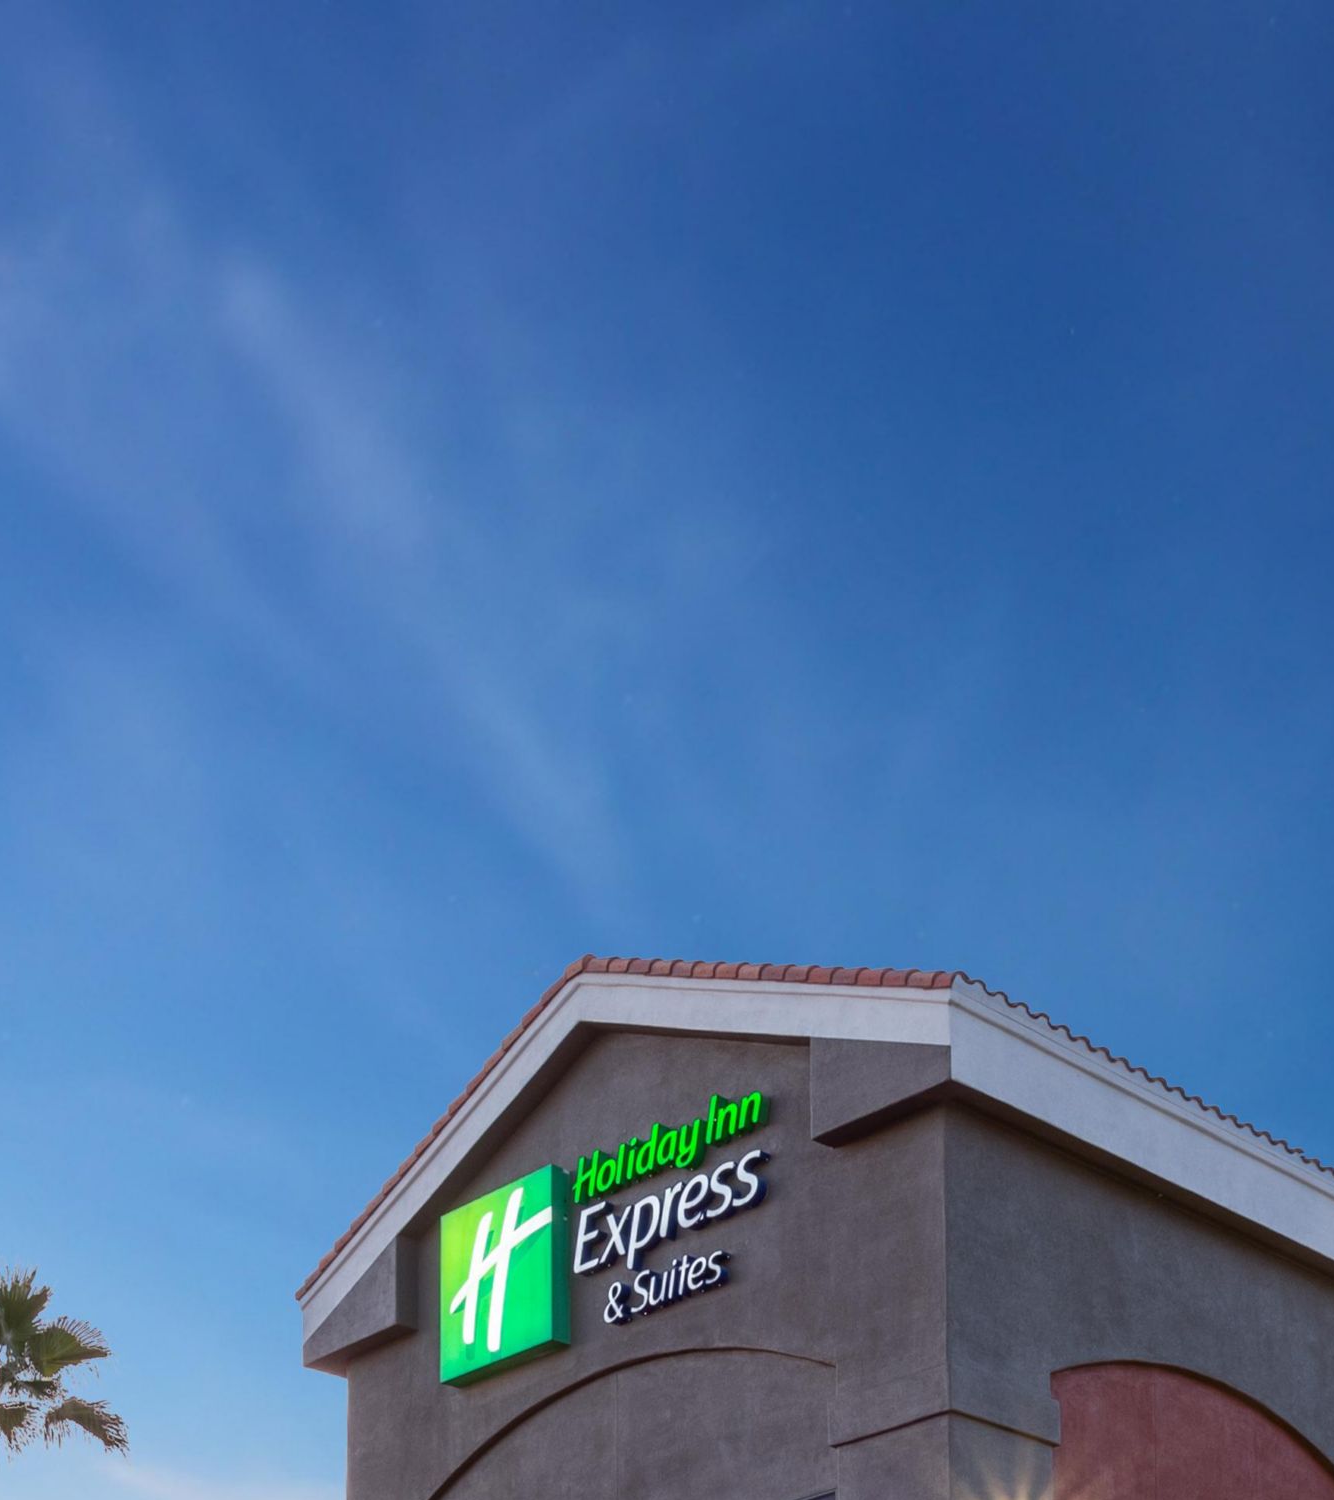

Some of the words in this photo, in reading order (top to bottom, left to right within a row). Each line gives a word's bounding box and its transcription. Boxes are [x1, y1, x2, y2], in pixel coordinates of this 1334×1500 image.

[572, 1119, 703, 1204] Holiday
[705, 1089, 765, 1146] Inn
[572, 1149, 764, 1275] Express
[603, 1281, 625, 1325] &
[630, 1250, 724, 1315] Suites
